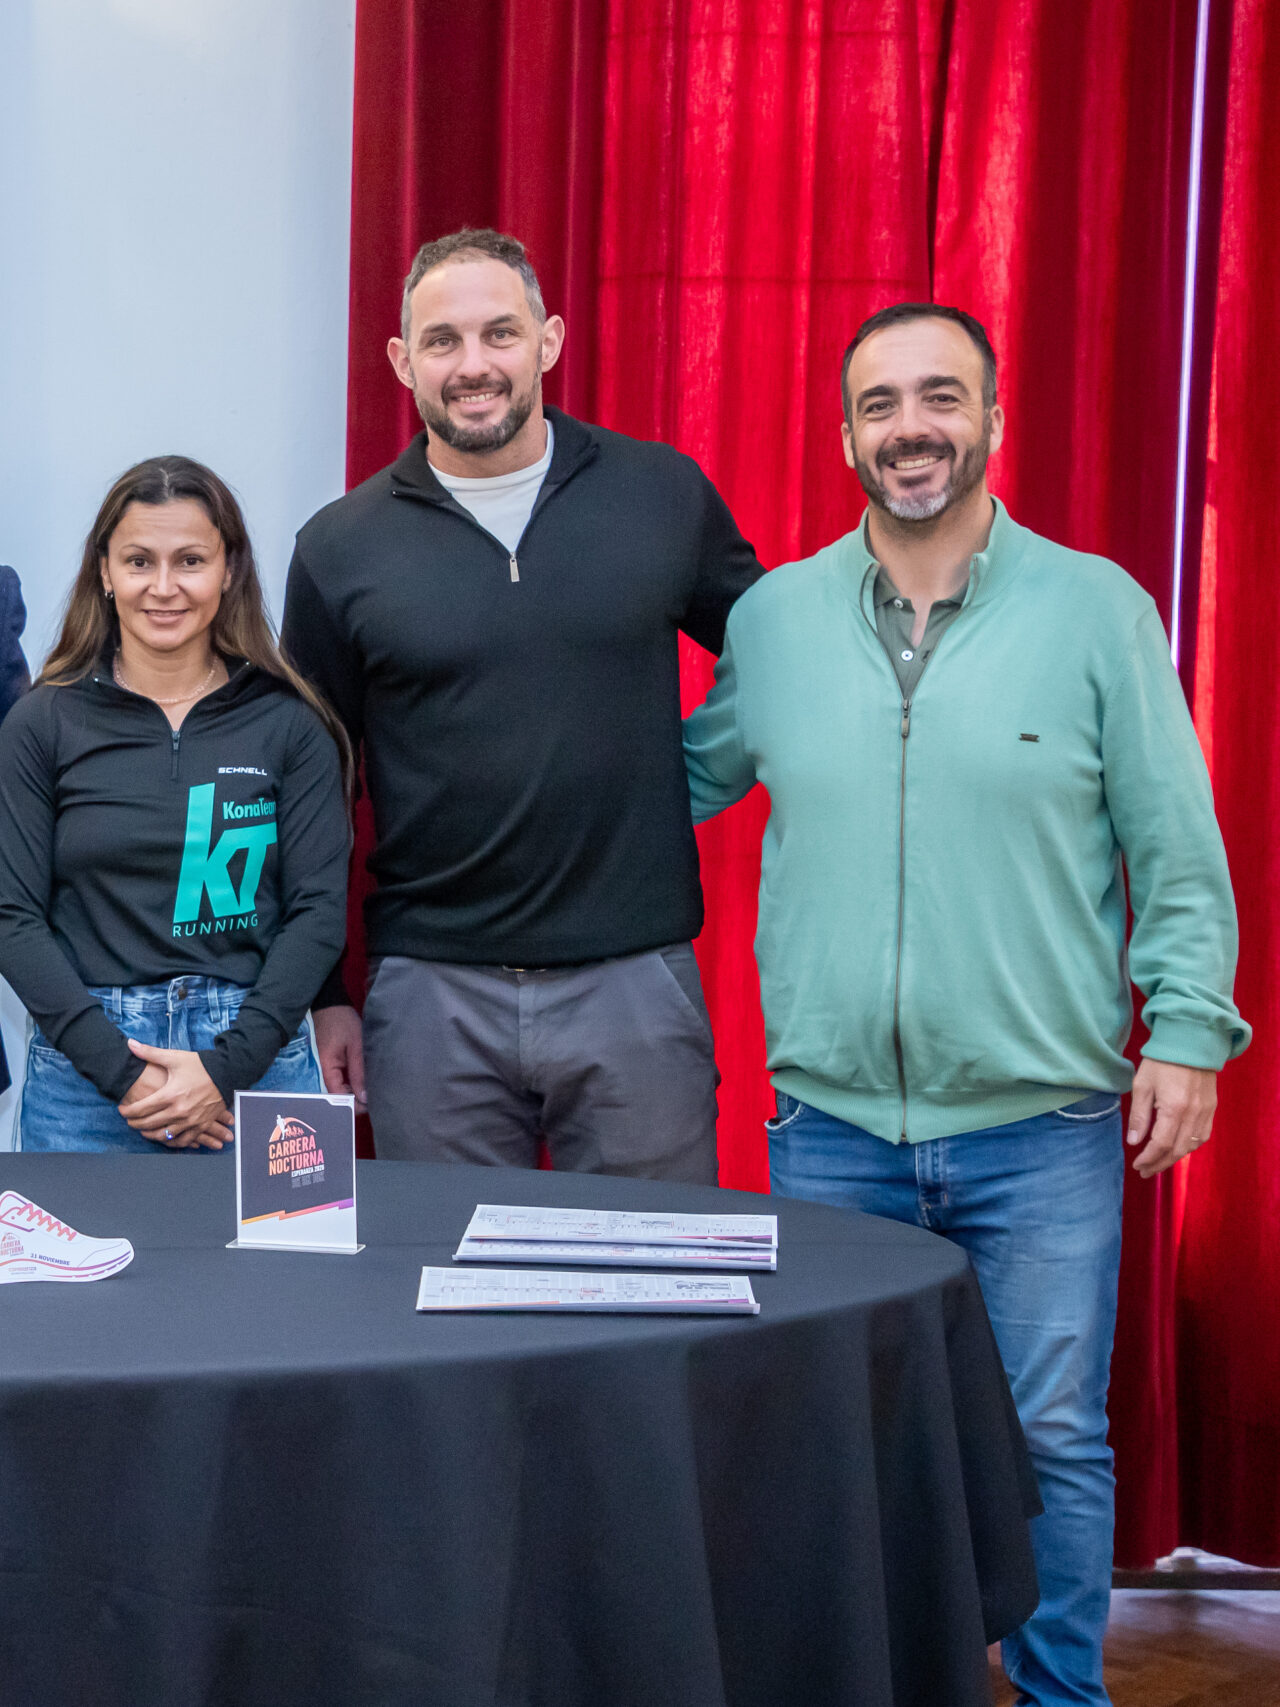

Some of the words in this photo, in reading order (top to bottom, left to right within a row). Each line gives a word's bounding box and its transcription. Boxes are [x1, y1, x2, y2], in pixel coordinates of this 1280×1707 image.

[218, 766, 267, 776] SCHNELL
[172, 914, 259, 937] RUNNING
[269, 1134, 316, 1160] CARRERA
[269, 1148, 325, 1176] NOCTURNA
[38, 1254, 71, 1266] NOVIEMBRE
